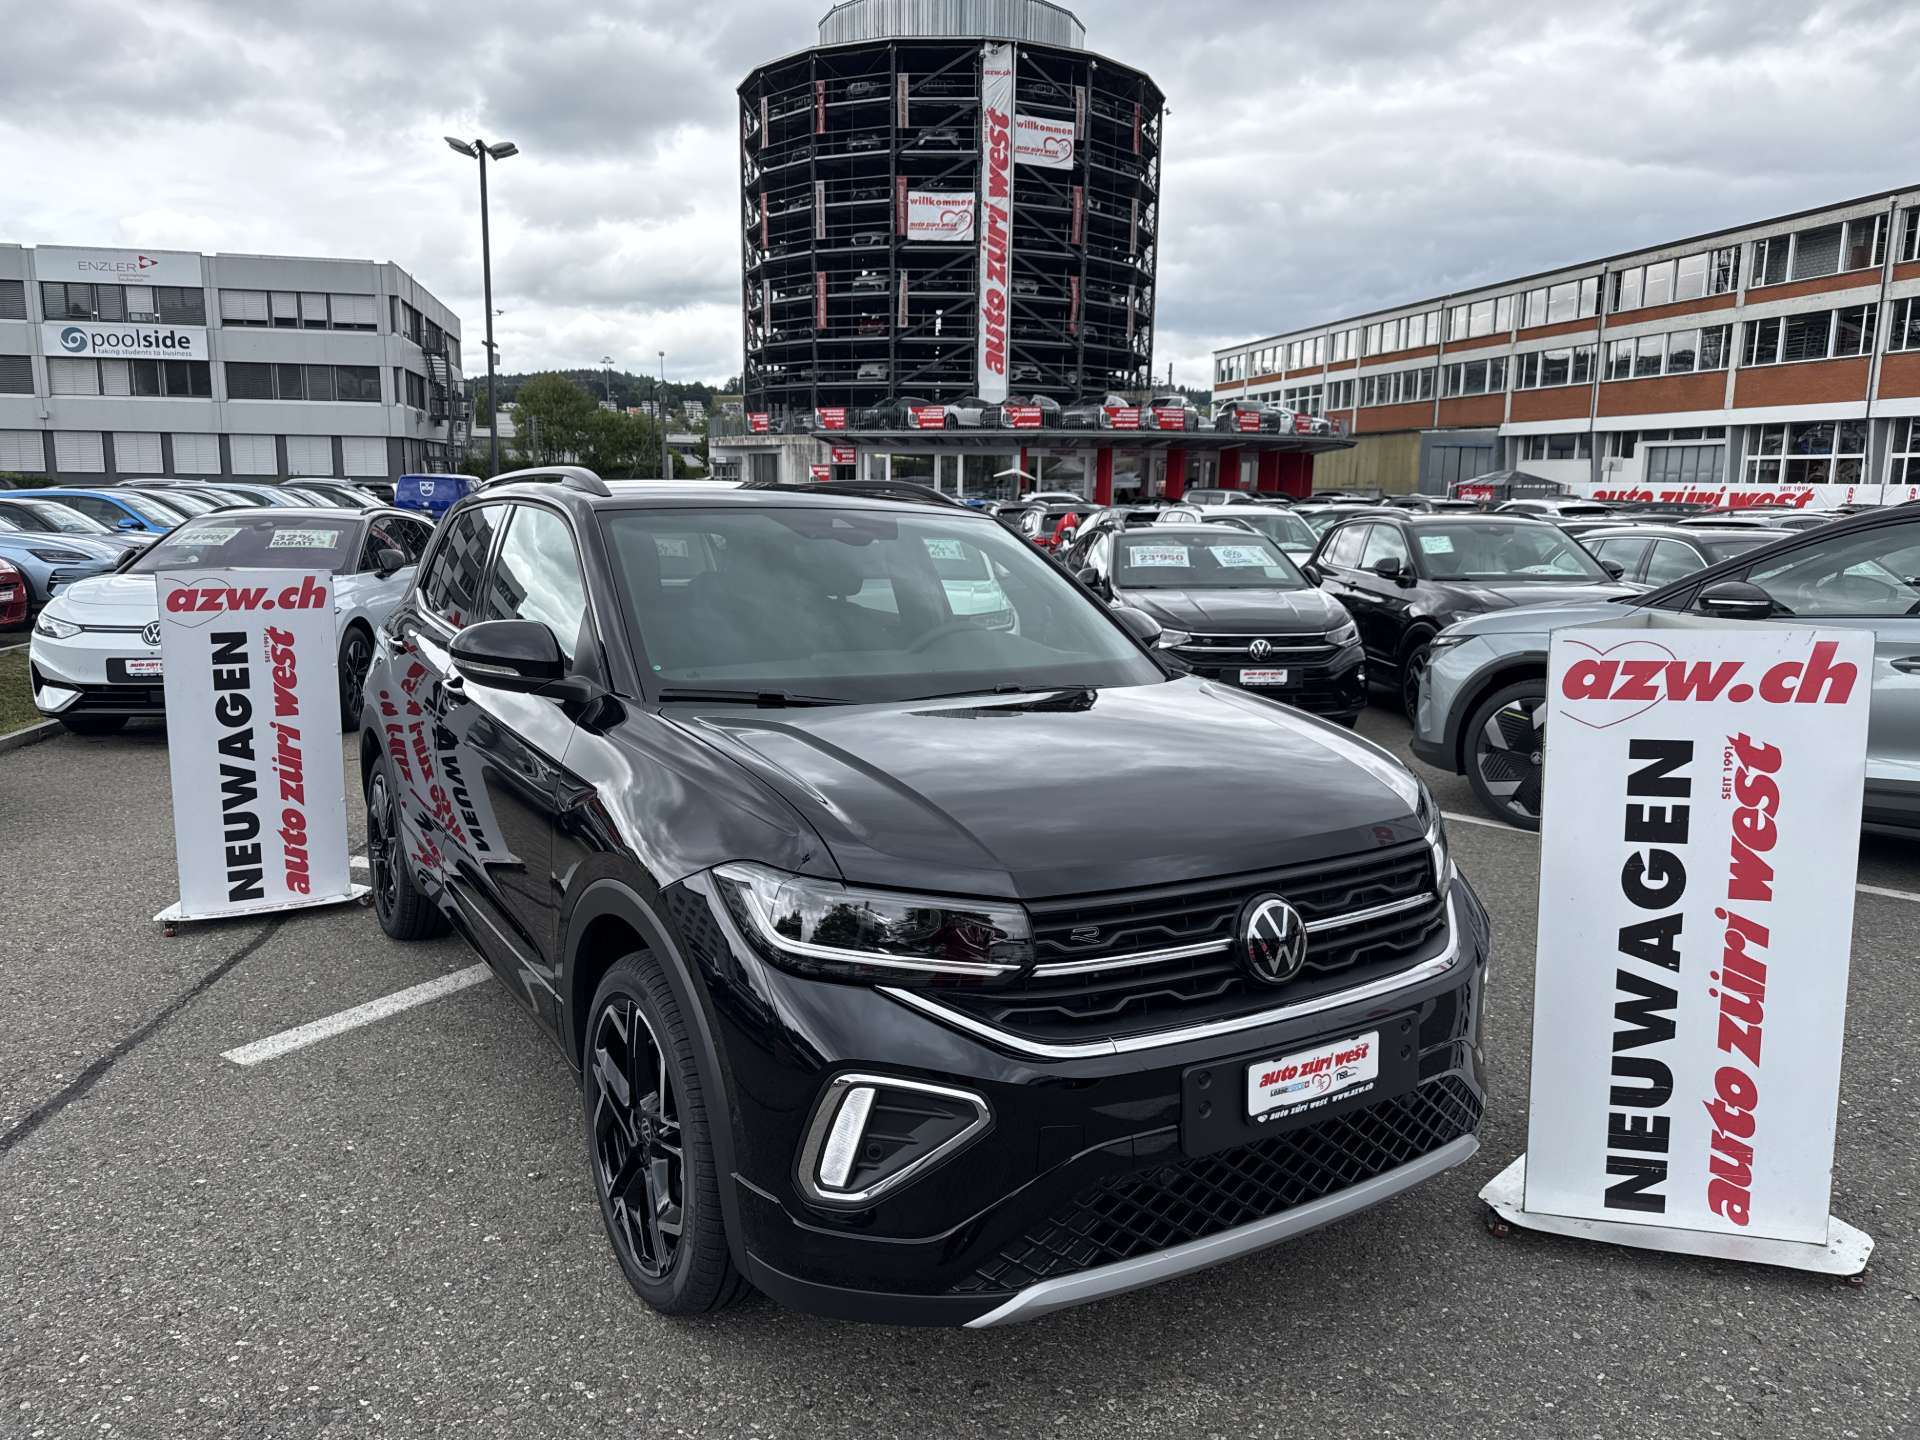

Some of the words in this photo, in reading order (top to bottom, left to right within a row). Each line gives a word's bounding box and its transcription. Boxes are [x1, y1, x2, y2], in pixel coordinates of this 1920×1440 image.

[986, 106, 1010, 198] west
[1016, 120, 1073, 135] willkommen
[910, 196, 973, 206] willkommen
[78, 261, 137, 272] ENZLER
[982, 201, 1008, 288] züri
[91, 329, 191, 353] poolside
[982, 288, 1006, 376] auto
[1592, 486, 1654, 503] auto
[274, 534, 314, 542] 32%
[166, 576, 327, 612] azw.ch
[264, 626, 299, 717] west
[1562, 641, 1858, 704] azw.ch
[210, 632, 264, 902] NEUWAGEN
[269, 721, 305, 806] züri
[1721, 776, 1732, 800] SEIT
[1723, 746, 1734, 772] 1991
[1726, 732, 1783, 902] west
[277, 807, 310, 895] auto
[1604, 739, 1694, 1214] NEUWAGEN
[1709, 907, 1770, 1068] züri
[1259, 1064, 1298, 1088] auto
[1299, 1053, 1334, 1077] züri
[1335, 1043, 1369, 1067] west
[1269, 1109, 1289, 1120] auto
[1290, 1102, 1309, 1115] züri
[1310, 1097, 1328, 1109] west
[1332, 1082, 1375, 1102] www.azw.ch
[1702, 1066, 1758, 1227] auto
